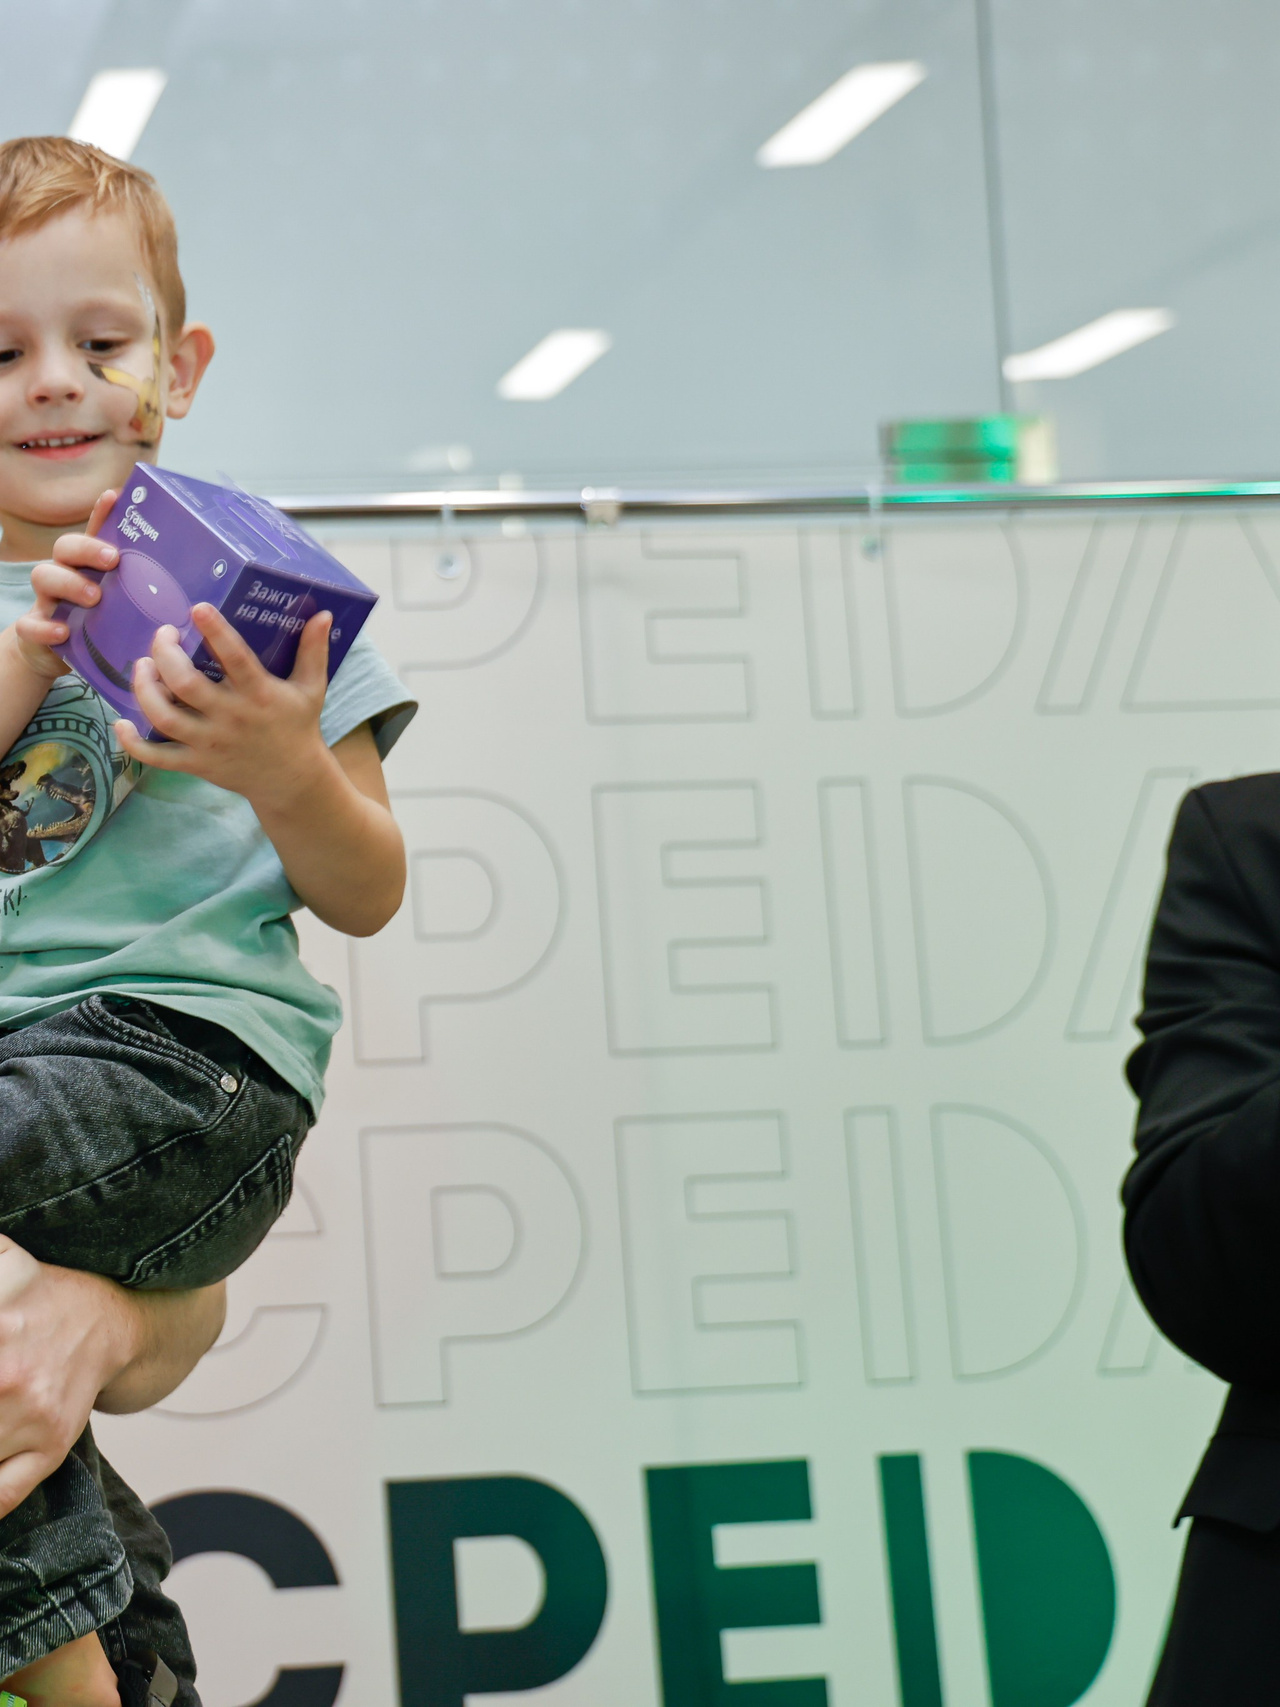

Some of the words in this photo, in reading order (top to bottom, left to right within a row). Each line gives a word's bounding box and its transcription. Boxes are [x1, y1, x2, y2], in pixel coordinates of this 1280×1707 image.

[117, 517, 141, 543] Лайт
[125, 505, 159, 542] Станция
[247, 580, 299, 612] Зажгу
[236, 603, 260, 620] на
[258, 608, 342, 641] вечере
